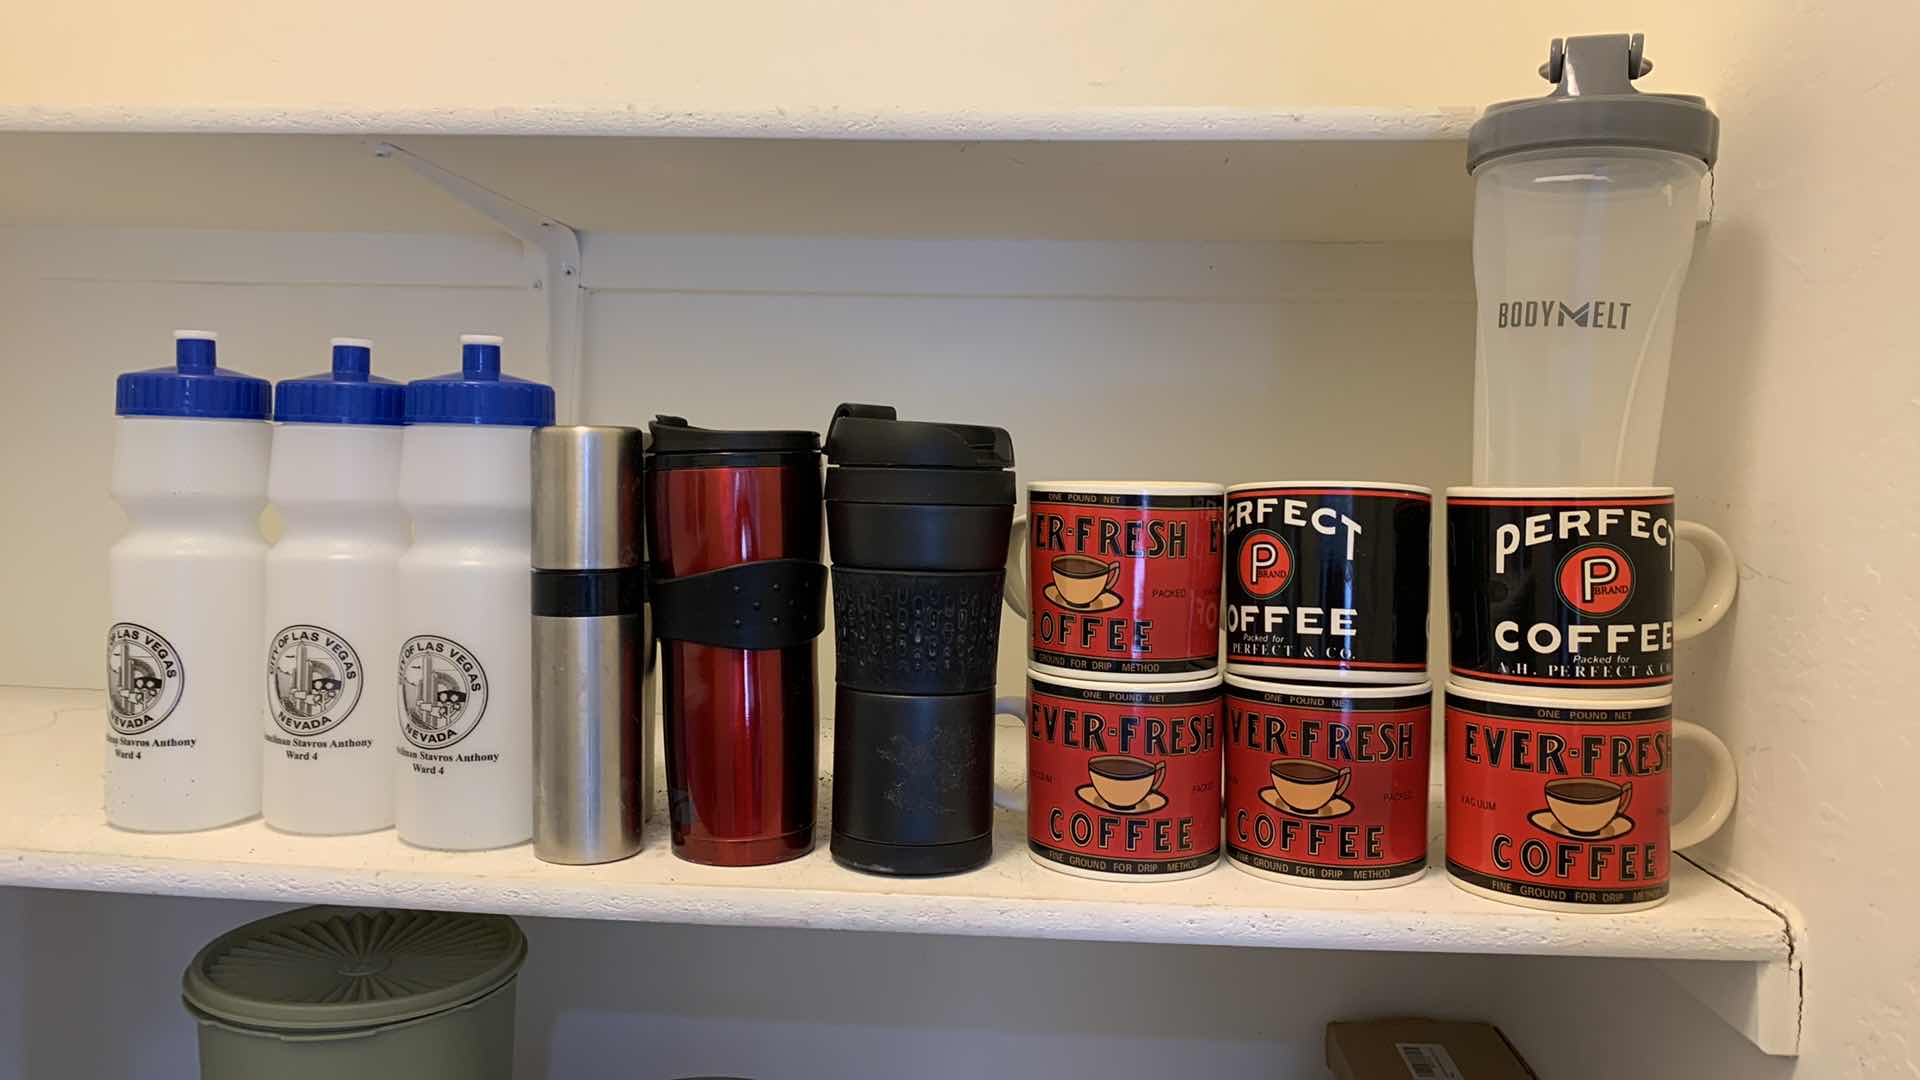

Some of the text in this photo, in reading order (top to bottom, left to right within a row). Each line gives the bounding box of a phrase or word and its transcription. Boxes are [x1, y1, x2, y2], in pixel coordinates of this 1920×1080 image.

[1498, 301, 1631, 329] BODYMELT
[1067, 494, 1097, 503] POUND
[1103, 495, 1120, 504] NET
[1252, 544, 1277, 583] P
[1257, 569, 1287, 579] BRAND
[1583, 557, 1617, 602] P
[1593, 585, 1629, 595] BRAND
[1033, 610, 1153, 653] OFFEE
[1243, 633, 1285, 644] Packed for
[144, 636, 177, 678] VEGAS
[278, 635, 289, 648] OF
[292, 631, 319, 642] LAS
[325, 638, 357, 680] VEGAS
[1233, 644, 1356, 660] PERFECT & CO.
[1573, 655, 1630, 664] Packed for
[405, 642, 482, 692] OF LAS VEGAS
[1070, 656, 1086, 669] FOR
[1092, 660, 1112, 671] DRIP
[1122, 663, 1160, 673] METHOD
[1549, 665, 1639, 677] PERFECT
[1645, 664, 1656, 675] &
[1083, 690, 1165, 703] ONE POUND NET
[1264, 693, 1282, 703] ONE
[1290, 696, 1324, 706] POUND
[278, 711, 332, 730] NEVADA
[1537, 709, 1632, 720] ONE POUND NET
[405, 724, 458, 743] NEVADA
[1032, 702, 1215, 756] EVER-FRESH
[152, 737, 197, 748] Anthony
[292, 738, 327, 748] Stavros
[329, 738, 373, 749] Anthony
[135, 751, 142, 760] 4
[286, 750, 318, 761] Ward 4
[420, 751, 453, 762] Stavros
[455, 752, 499, 763] Anthony
[412, 763, 445, 775] Ward 4
[1049, 807, 1193, 853] COFFEE
[1237, 809, 1384, 859] COFFEE
[1069, 857, 1105, 870] GROUND
[1113, 862, 1132, 872] FOR
[1138, 863, 1158, 872] DRIP
[1167, 859, 1198, 871] METHOD
[1491, 834, 1656, 881] COFFEE
[1254, 857, 1288, 871] GROUND
[1296, 866, 1315, 877] FOR
[1321, 869, 1343, 879] DRIP
[1354, 869, 1390, 879] METHOD
[1492, 880, 1512, 892] FINE
[1520, 887, 1566, 900] GROUND
[1576, 892, 1596, 901] FOR
[1602, 893, 1623, 901] DRIP
